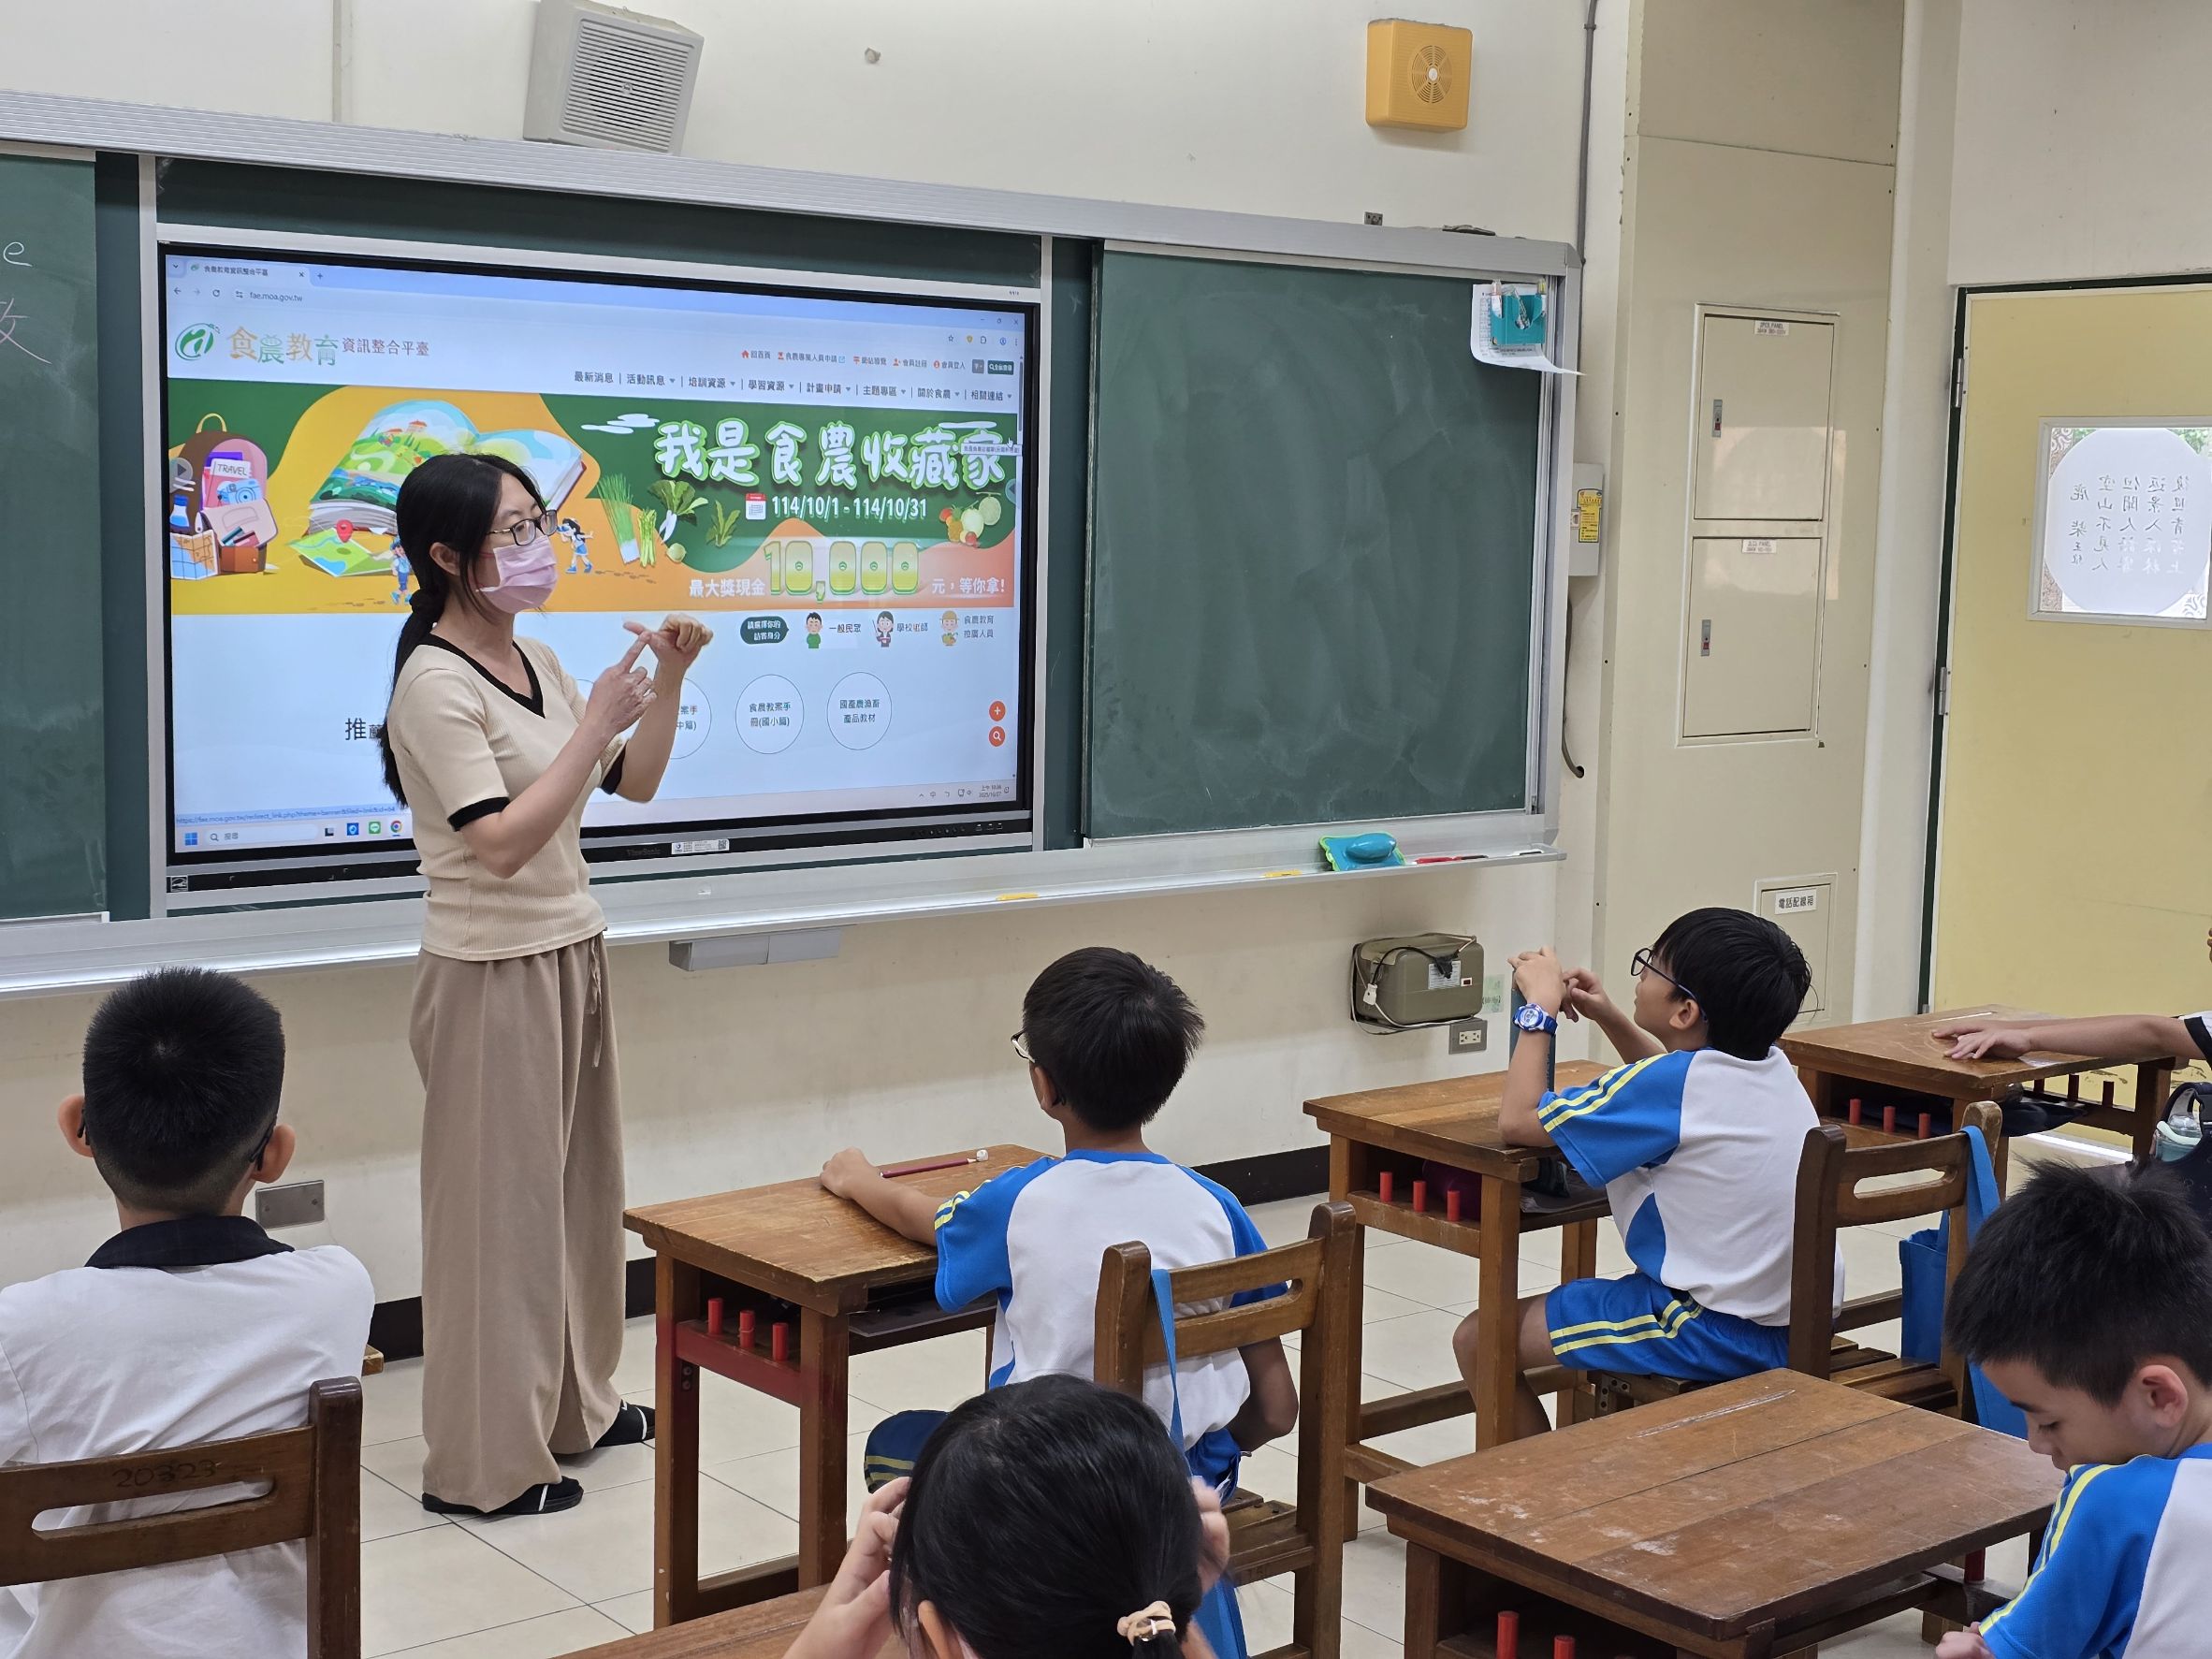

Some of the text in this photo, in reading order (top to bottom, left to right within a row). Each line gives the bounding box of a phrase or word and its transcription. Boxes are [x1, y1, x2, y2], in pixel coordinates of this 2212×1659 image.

[249, 291, 303, 302] fae.moa.gov.tw
[226, 327, 429, 366] 食農教育 資訊整合平臺
[575, 371, 614, 384] 最新消息
[626, 373, 665, 386] 活動訊息
[688, 376, 726, 388] 培訓資源
[749, 379, 785, 391] 學習資源
[807, 382, 841, 394] 計畫申請
[863, 385, 897, 397] 主題專區
[917, 387, 951, 400] 關於食農
[970, 390, 1004, 401] 相關連結
[655, 417, 1006, 490] 我是食農收藏家
[217, 463, 248, 476] TRAVEL
[771, 495, 839, 524] 114/10/1
[853, 496, 927, 524] 114/10/31
[689, 577, 765, 599] 最大獎現金
[764, 540, 919, 604] 10,000
[964, 615, 995, 625] 食農教育
